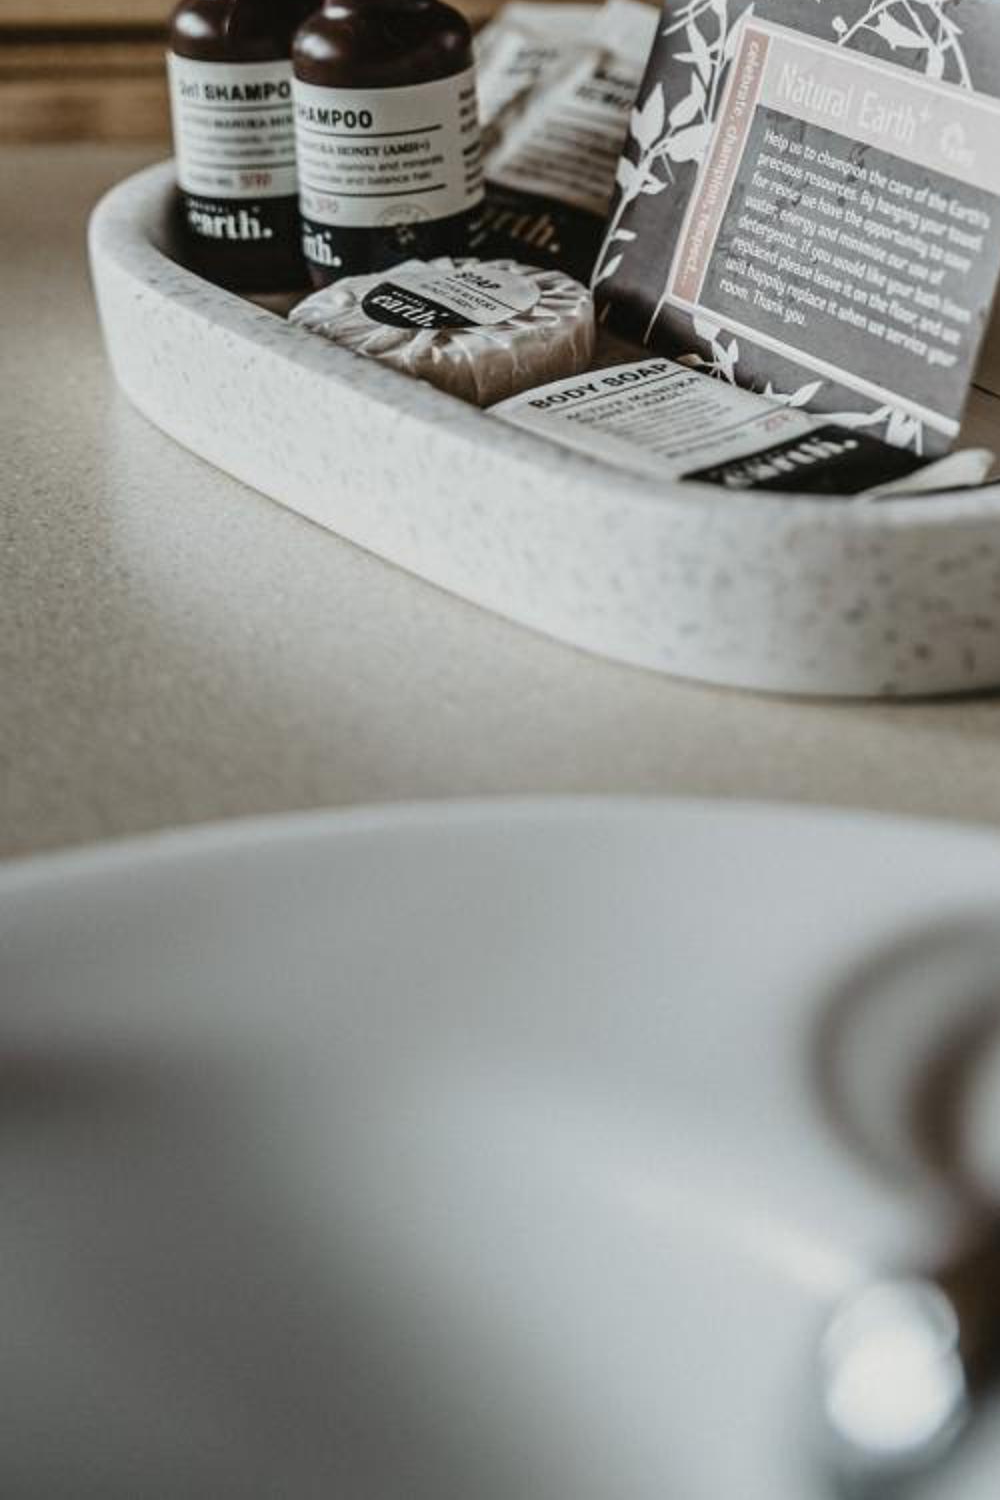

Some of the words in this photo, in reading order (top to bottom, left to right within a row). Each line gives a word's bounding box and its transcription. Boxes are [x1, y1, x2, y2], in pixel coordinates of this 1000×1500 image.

[203, 79, 292, 101] SHAMPO
[775, 62, 854, 118] Natural
[299, 106, 374, 130] HAMPOO
[764, 129, 788, 153] Help
[817, 150, 868, 183] champion
[887, 179, 914, 198] care
[756, 152, 803, 184] precious
[875, 195, 919, 230] hanging
[779, 207, 816, 236] energy
[817, 196, 844, 219] have
[187, 210, 274, 240] earth.
[777, 255, 813, 279] please
[812, 267, 842, 292] leave
[831, 255, 866, 278] would
[865, 265, 887, 287] like
[724, 256, 747, 275] will
[745, 263, 786, 296] happily
[785, 283, 826, 310] replace
[837, 307, 867, 328] when
[754, 290, 784, 315] Thank
[527, 382, 600, 410] BODY
[600, 362, 669, 389] SOAP
